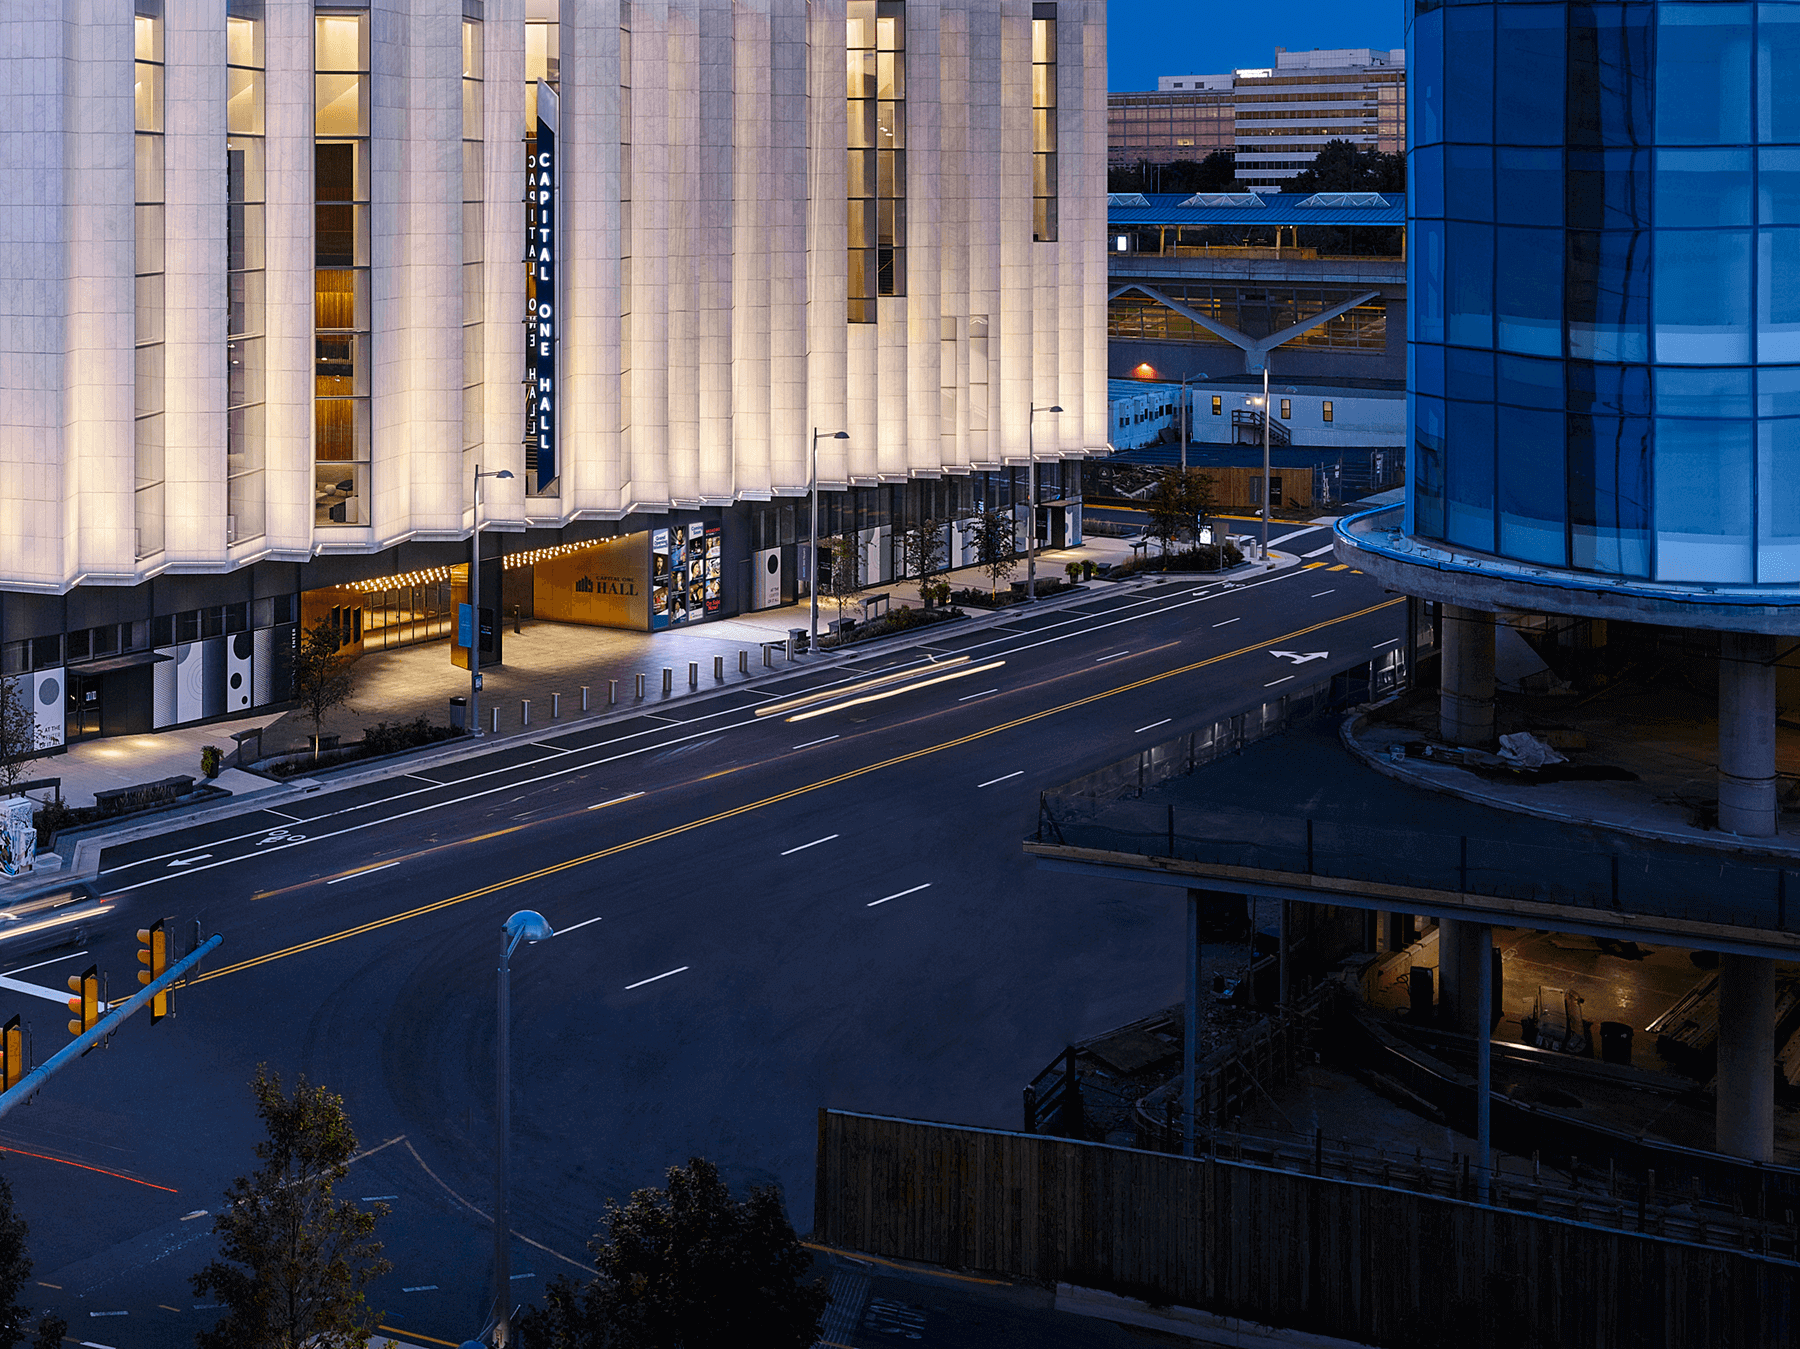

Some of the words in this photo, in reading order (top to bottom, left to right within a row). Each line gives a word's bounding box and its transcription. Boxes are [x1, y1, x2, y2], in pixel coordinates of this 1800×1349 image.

[539, 152, 551, 281] CAPITAL
[539, 303, 551, 356] ONE
[539, 377, 551, 449] HALL
[597, 582, 638, 596] HALL
